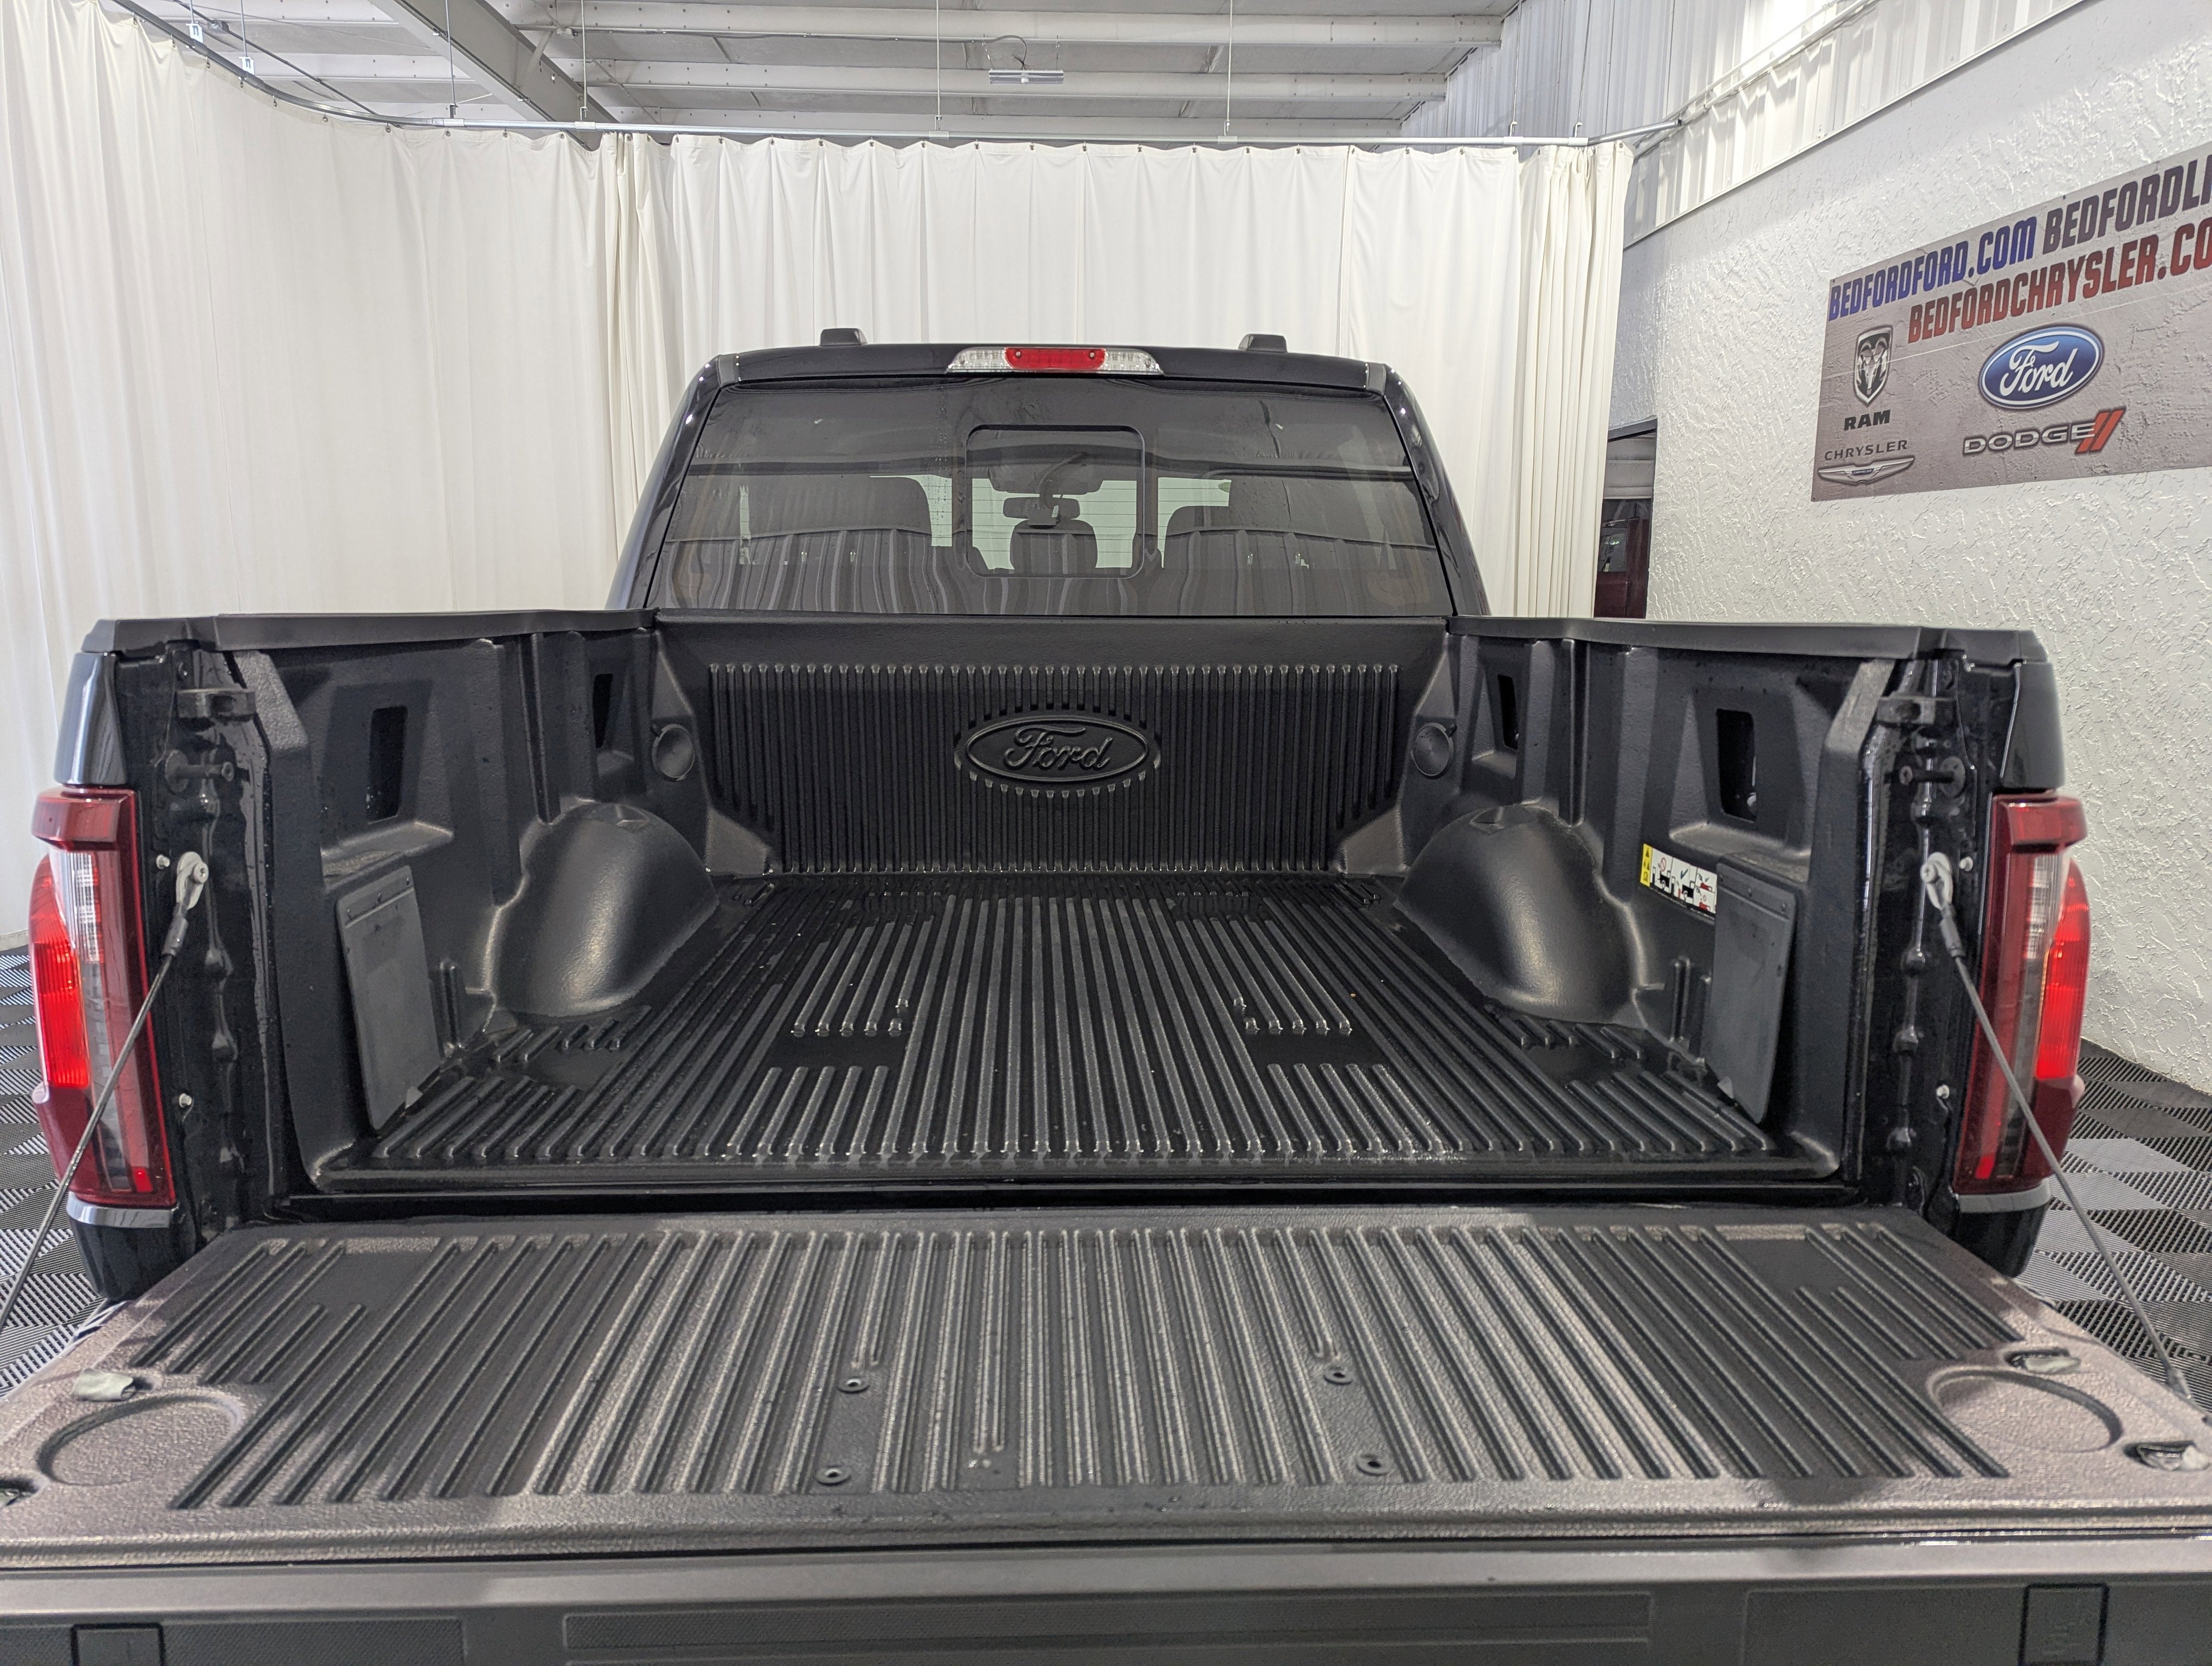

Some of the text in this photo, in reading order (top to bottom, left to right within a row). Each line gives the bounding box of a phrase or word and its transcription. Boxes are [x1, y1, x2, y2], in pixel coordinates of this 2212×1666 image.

[1829, 216, 2037, 321] BEDFORDFORD.COM
[1999, 341, 2078, 396] Ford
[1844, 409, 1891, 431] RAM
[1964, 422, 2096, 453] DODGE
[1824, 440, 1908, 460] CHRYSLER
[1004, 725, 1113, 769] Ford
